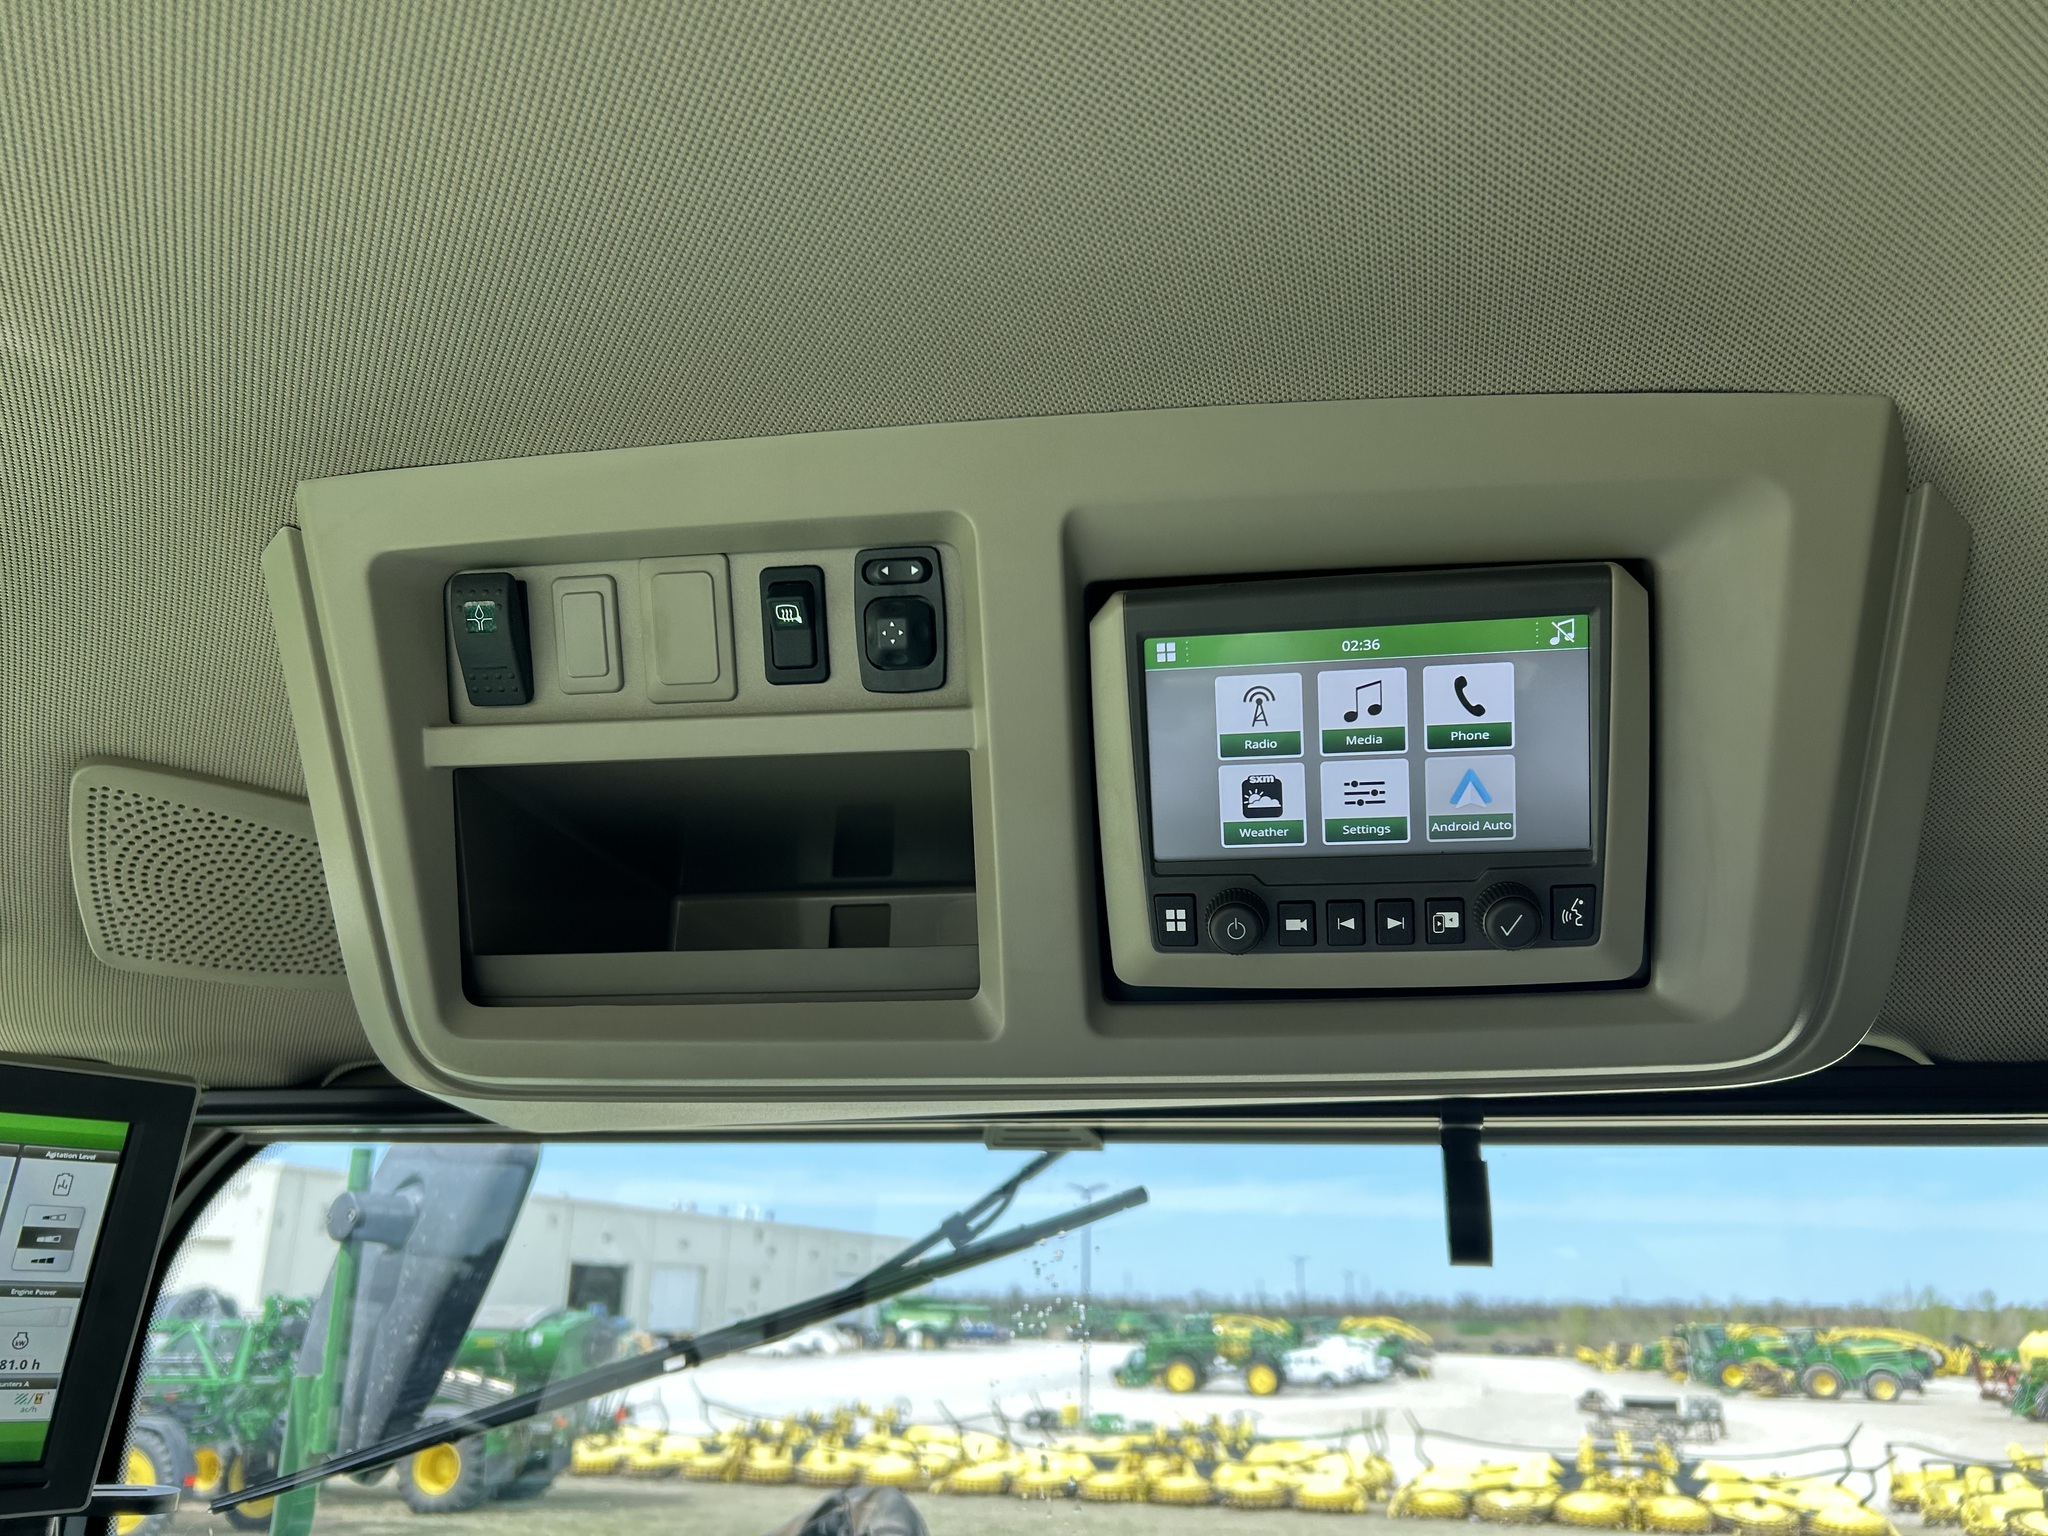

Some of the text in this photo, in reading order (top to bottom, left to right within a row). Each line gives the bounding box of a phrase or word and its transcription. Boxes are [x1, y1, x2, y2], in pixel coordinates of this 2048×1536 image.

[1341, 638, 1381, 652] 02:36
[1345, 734, 1383, 746] Media
[1450, 729, 1490, 742] Phone
[1244, 738, 1278, 750] Radio
[1249, 774, 1275, 784] sxm
[1342, 823, 1391, 836] Settings
[1431, 819, 1512, 832] Android Auto
[1239, 826, 1289, 838] Weather
[46, 1151, 77, 1160] Agitation
[11, 1288, 33, 1296] Engine
[32, 1359, 40, 1370] h
[23, 1380, 30, 1388] A
